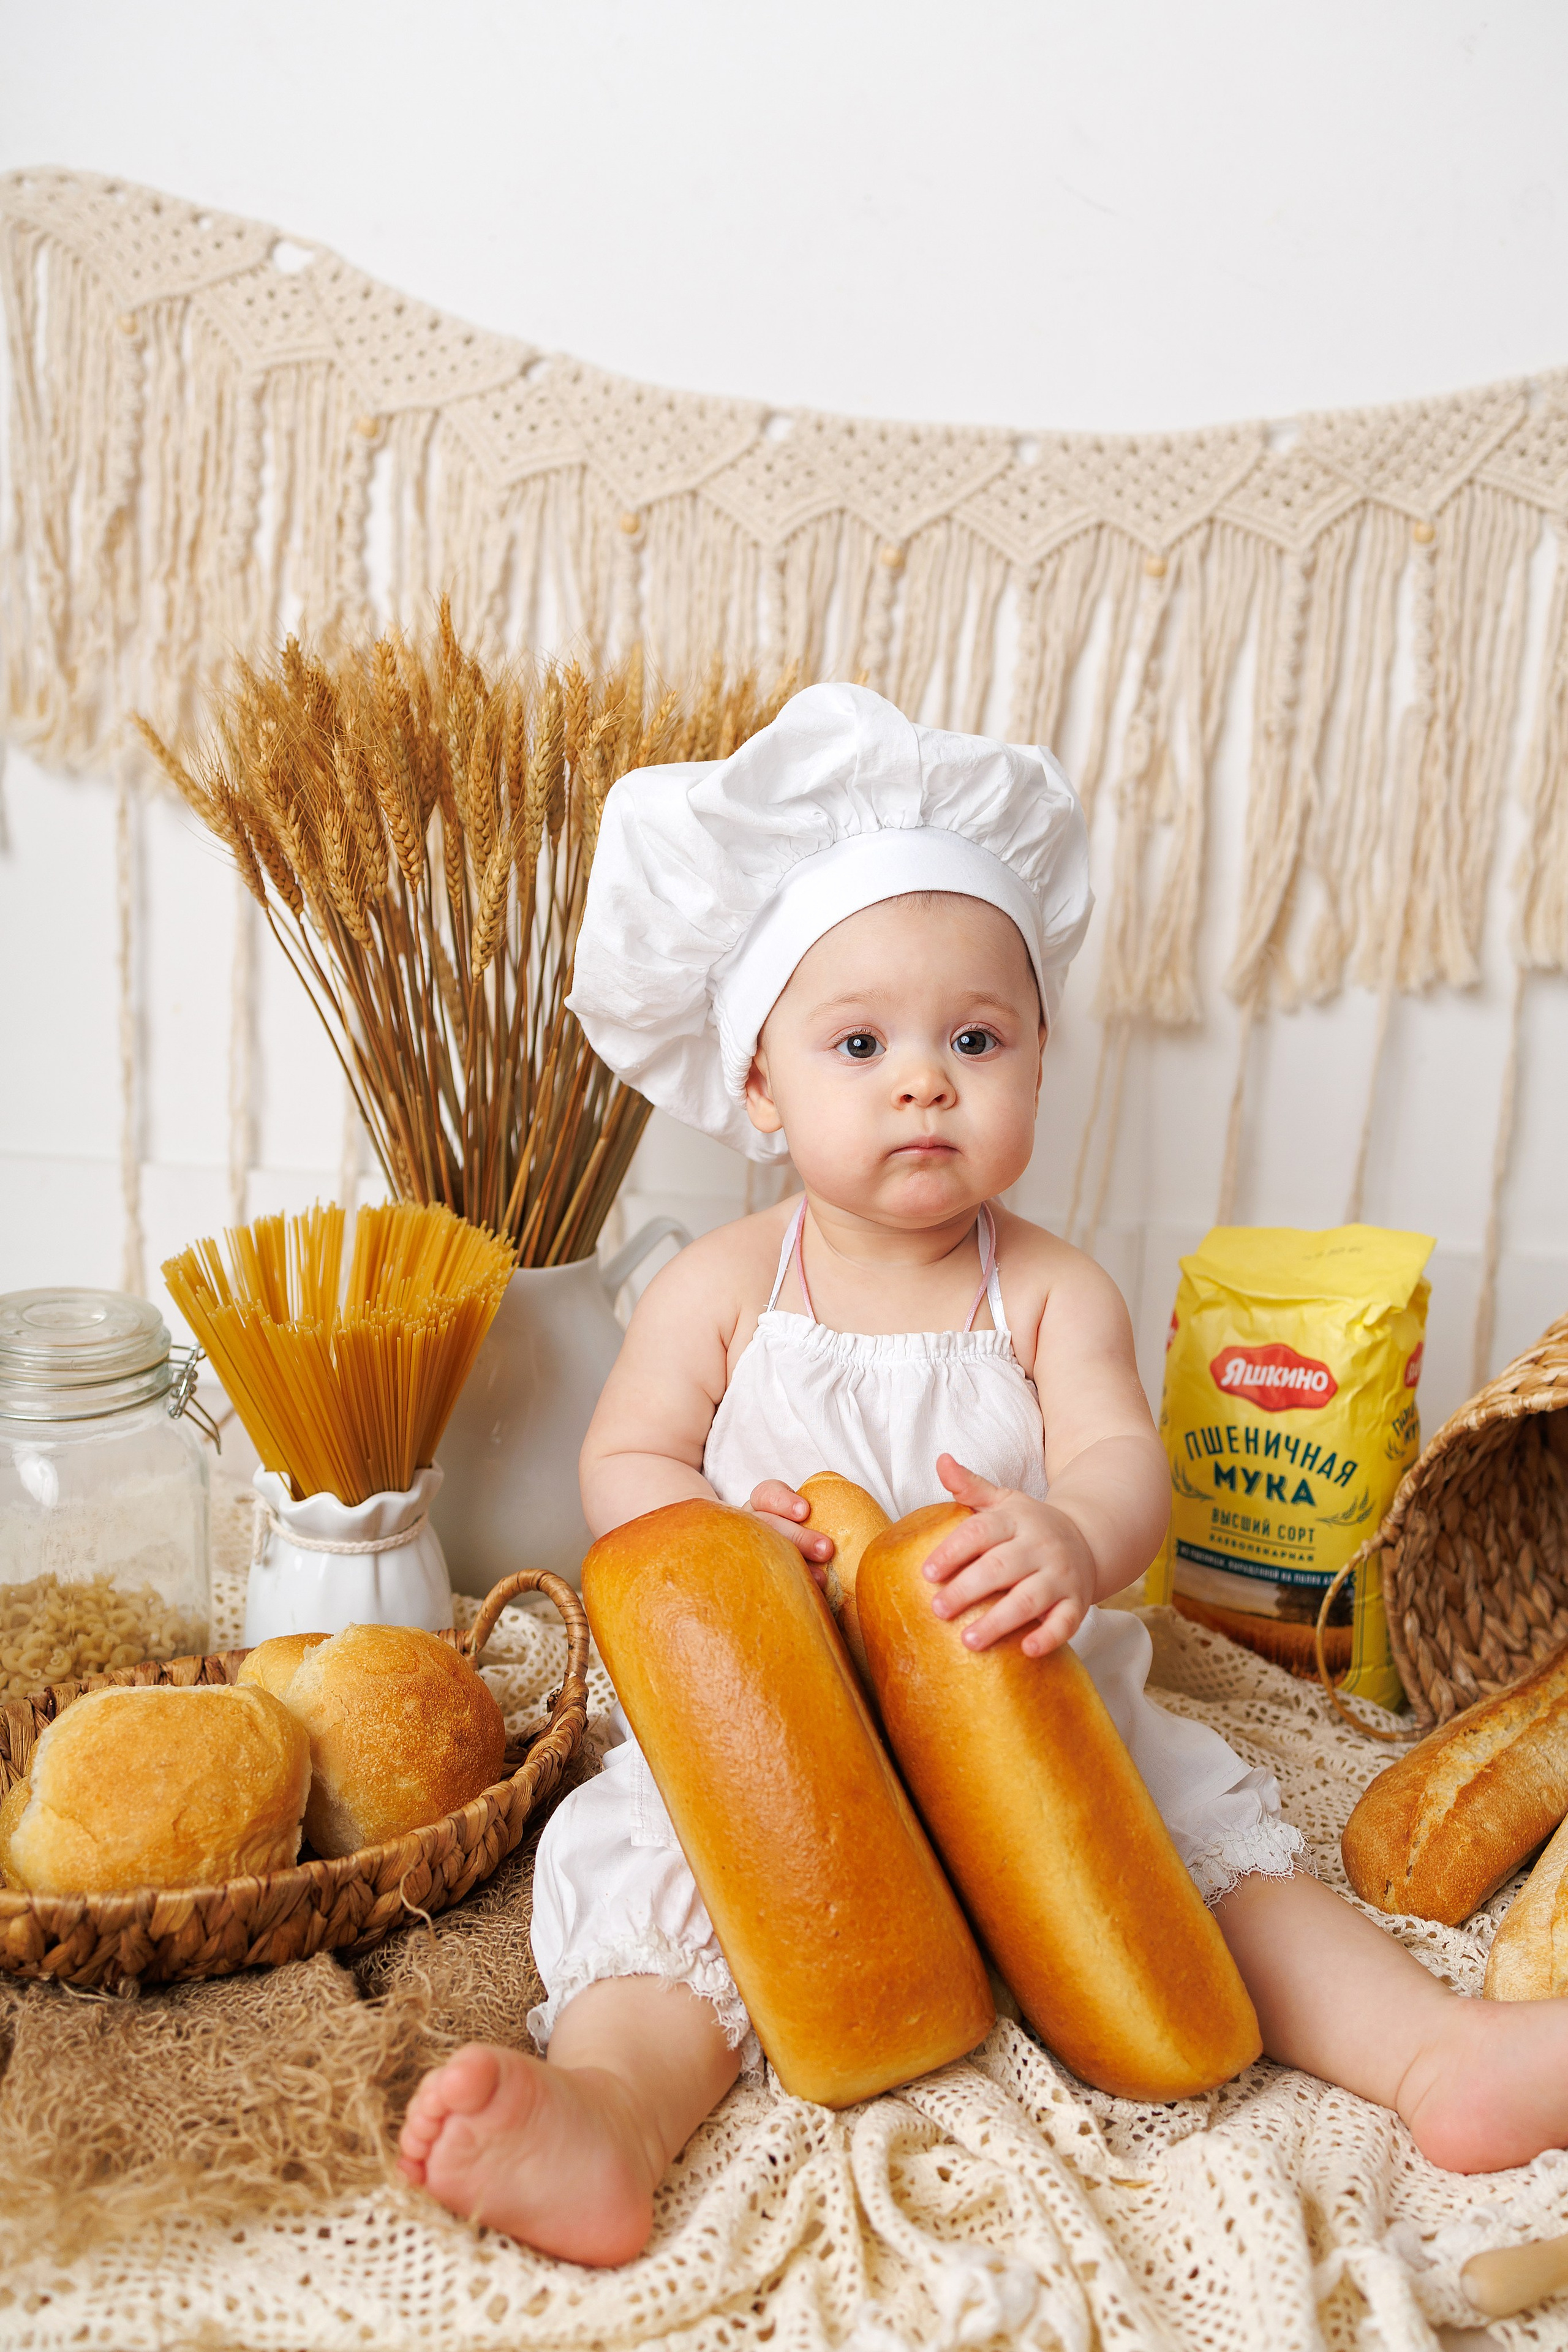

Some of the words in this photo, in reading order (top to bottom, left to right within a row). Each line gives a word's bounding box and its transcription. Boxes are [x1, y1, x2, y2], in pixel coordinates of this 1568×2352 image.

[1220, 1357, 1329, 1393] Яшкино
[1184, 1424, 1359, 1488] ПШЕНИЧНАЯ
[1213, 1460, 1316, 1507] МУКА
[1211, 1507, 1271, 1537] ВЫСШИЙ
[1277, 1523, 1316, 1544] СОРТ
